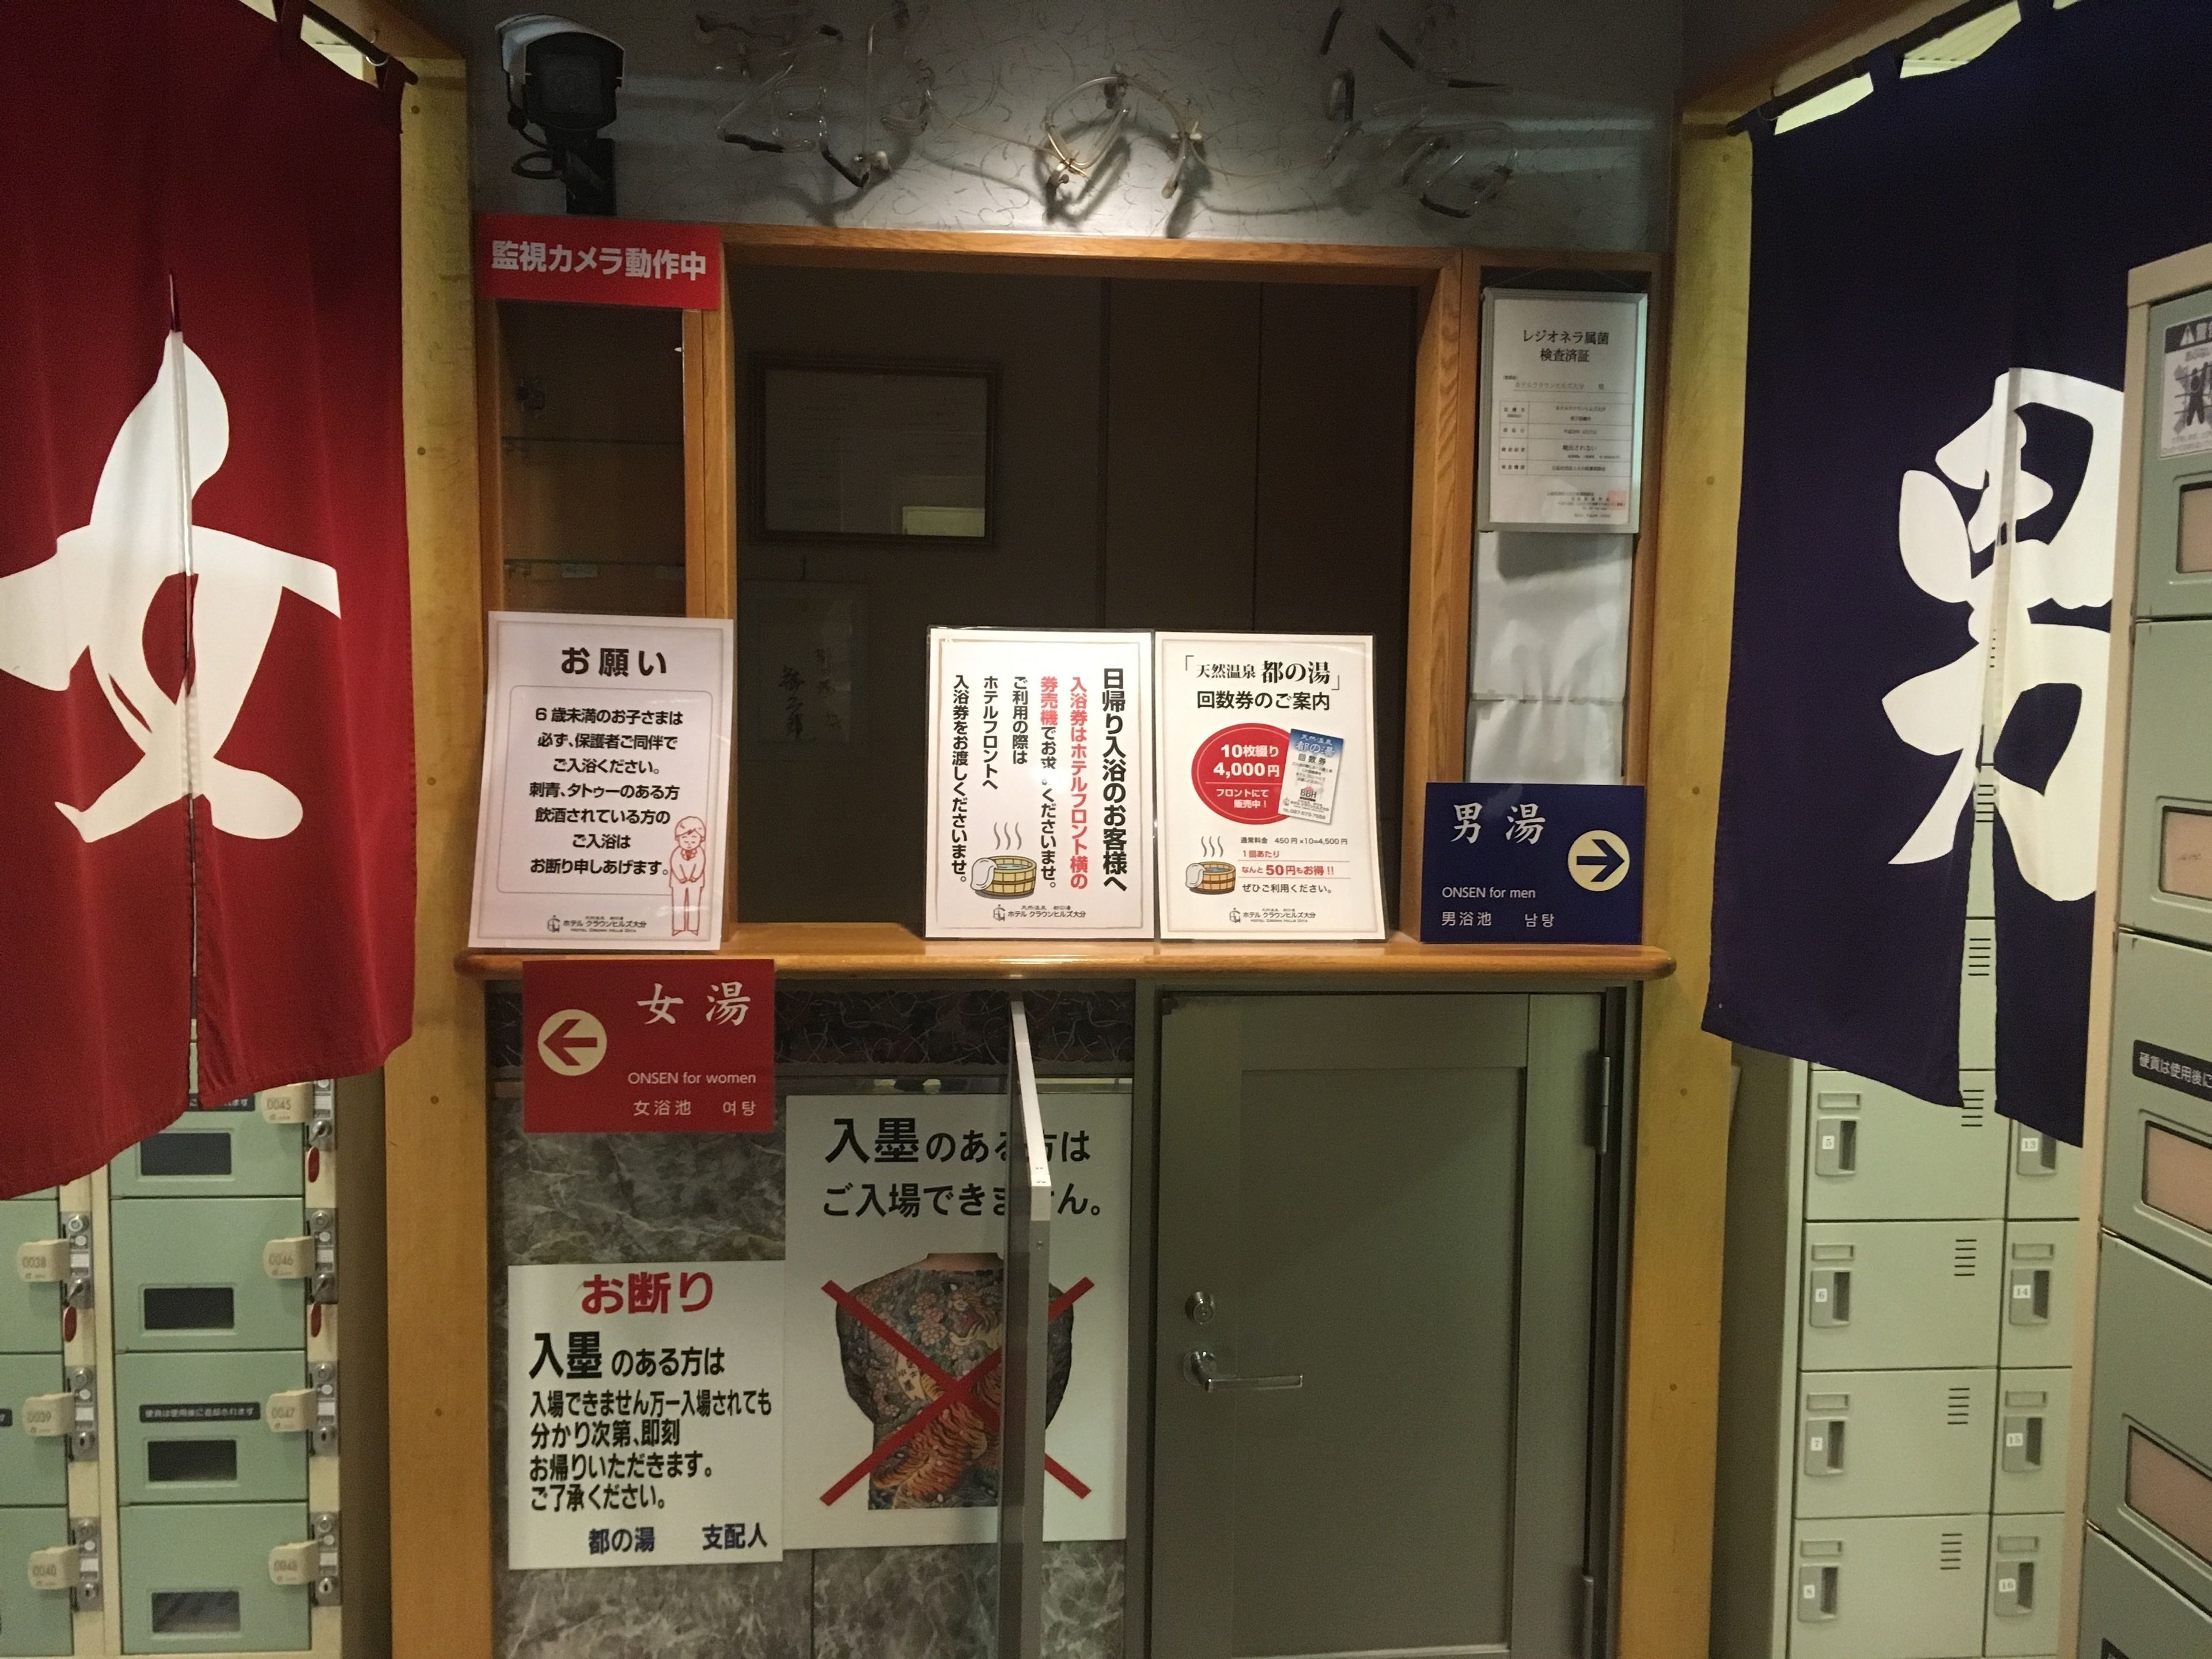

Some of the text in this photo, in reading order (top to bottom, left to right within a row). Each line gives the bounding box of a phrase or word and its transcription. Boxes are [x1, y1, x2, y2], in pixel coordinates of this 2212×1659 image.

[491, 240, 706, 281] 監視カメラ動作中
[1523, 329, 1609, 346] レジオネラ属菌
[1540, 348, 1590, 362] 検査済証
[561, 647, 667, 677] お願い
[1197, 691, 1330, 711] 回数券のご案内
[536, 707, 683, 725] 6歳未満のお子さまは
[1013, 676, 1028, 764] ご利用の際は
[983, 676, 998, 789] ホテルフロントへ
[537, 733, 677, 750] 必ず、保護者ご同伴で
[554, 759, 660, 775] ご入浴ください。
[1213, 762, 1280, 779] 4,000円
[952, 675, 969, 882] 入浴券をお渡しくださいませ。
[1040, 676, 1059, 888] 券売機でお求くださいませ。
[1070, 677, 1088, 889] 入浴券はホテルフロント横の
[1102, 668, 1127, 892] 日帰り入浴のお客様へ
[529, 782, 680, 800] 刺青、タトゥーのある方
[1217, 789, 1269, 798] フロントにて
[535, 808, 670, 824] 飲酒されている方の
[1450, 802, 1546, 844] 男湯
[573, 834, 631, 849] ご入浴は
[531, 859, 668, 876] お断り申しあげます。
[1242, 884, 1332, 893] ぜひご利用ください。
[1442, 887, 1536, 898] ONSEN for men
[1441, 911, 1492, 926] 男浴池
[637, 981, 751, 1027] 女湯
[628, 1071, 756, 1084] ONSEN for women
[267, 1098, 291, 1110] 0045
[634, 1100, 691, 1116] 女浴池
[2024, 1141, 2037, 1149] 13
[582, 1272, 713, 1314] お断り
[1819, 1291, 1825, 1299] 6
[2016, 1287, 2028, 1296] 14
[530, 1388, 772, 1418] 入場できません万一入場されても
[531, 1419, 680, 1450] 分かり次第、即刻
[2008, 1435, 2021, 1445] 15
[530, 1450, 712, 1482] お帰りいただきます。
[531, 1483, 665, 1512] ご了承ください。
[588, 1522, 767, 1555] 都の湯 支配人
[2001, 1581, 2014, 1590] 16
